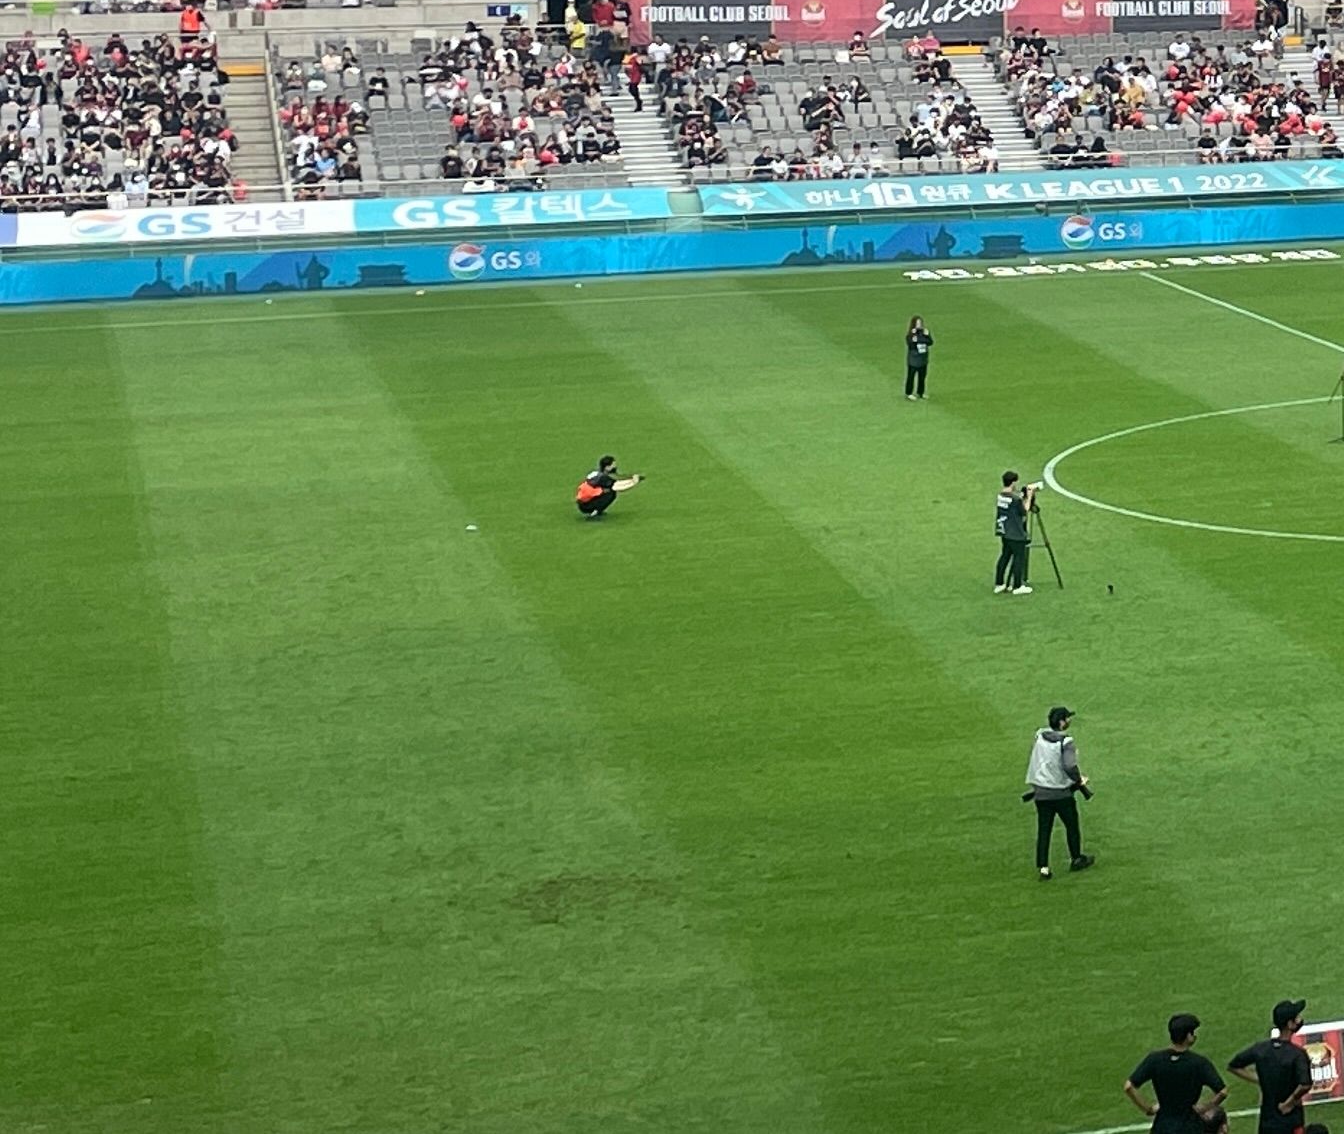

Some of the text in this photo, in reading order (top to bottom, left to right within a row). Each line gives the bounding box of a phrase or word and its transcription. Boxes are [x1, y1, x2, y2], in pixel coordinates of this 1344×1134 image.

[640, 5, 708, 23] FOOTBALL
[709, 5, 745, 23] CLUB
[749, 5, 790, 21] SEOUL
[1095, 1, 1157, 17] FOOTBALL
[1158, 0, 1190, 16] CLUB
[1194, 0, 1232, 15] SEOUL
[804, 188, 862, 207] 하나
[984, 182, 1017, 200] K
[1021, 177, 1164, 199] LEAGUE
[1167, 177, 1185, 193] 1
[1196, 172, 1268, 191] 2022
[137, 208, 305, 235] GS 건설
[393, 192, 634, 227] GS 칼텍스
